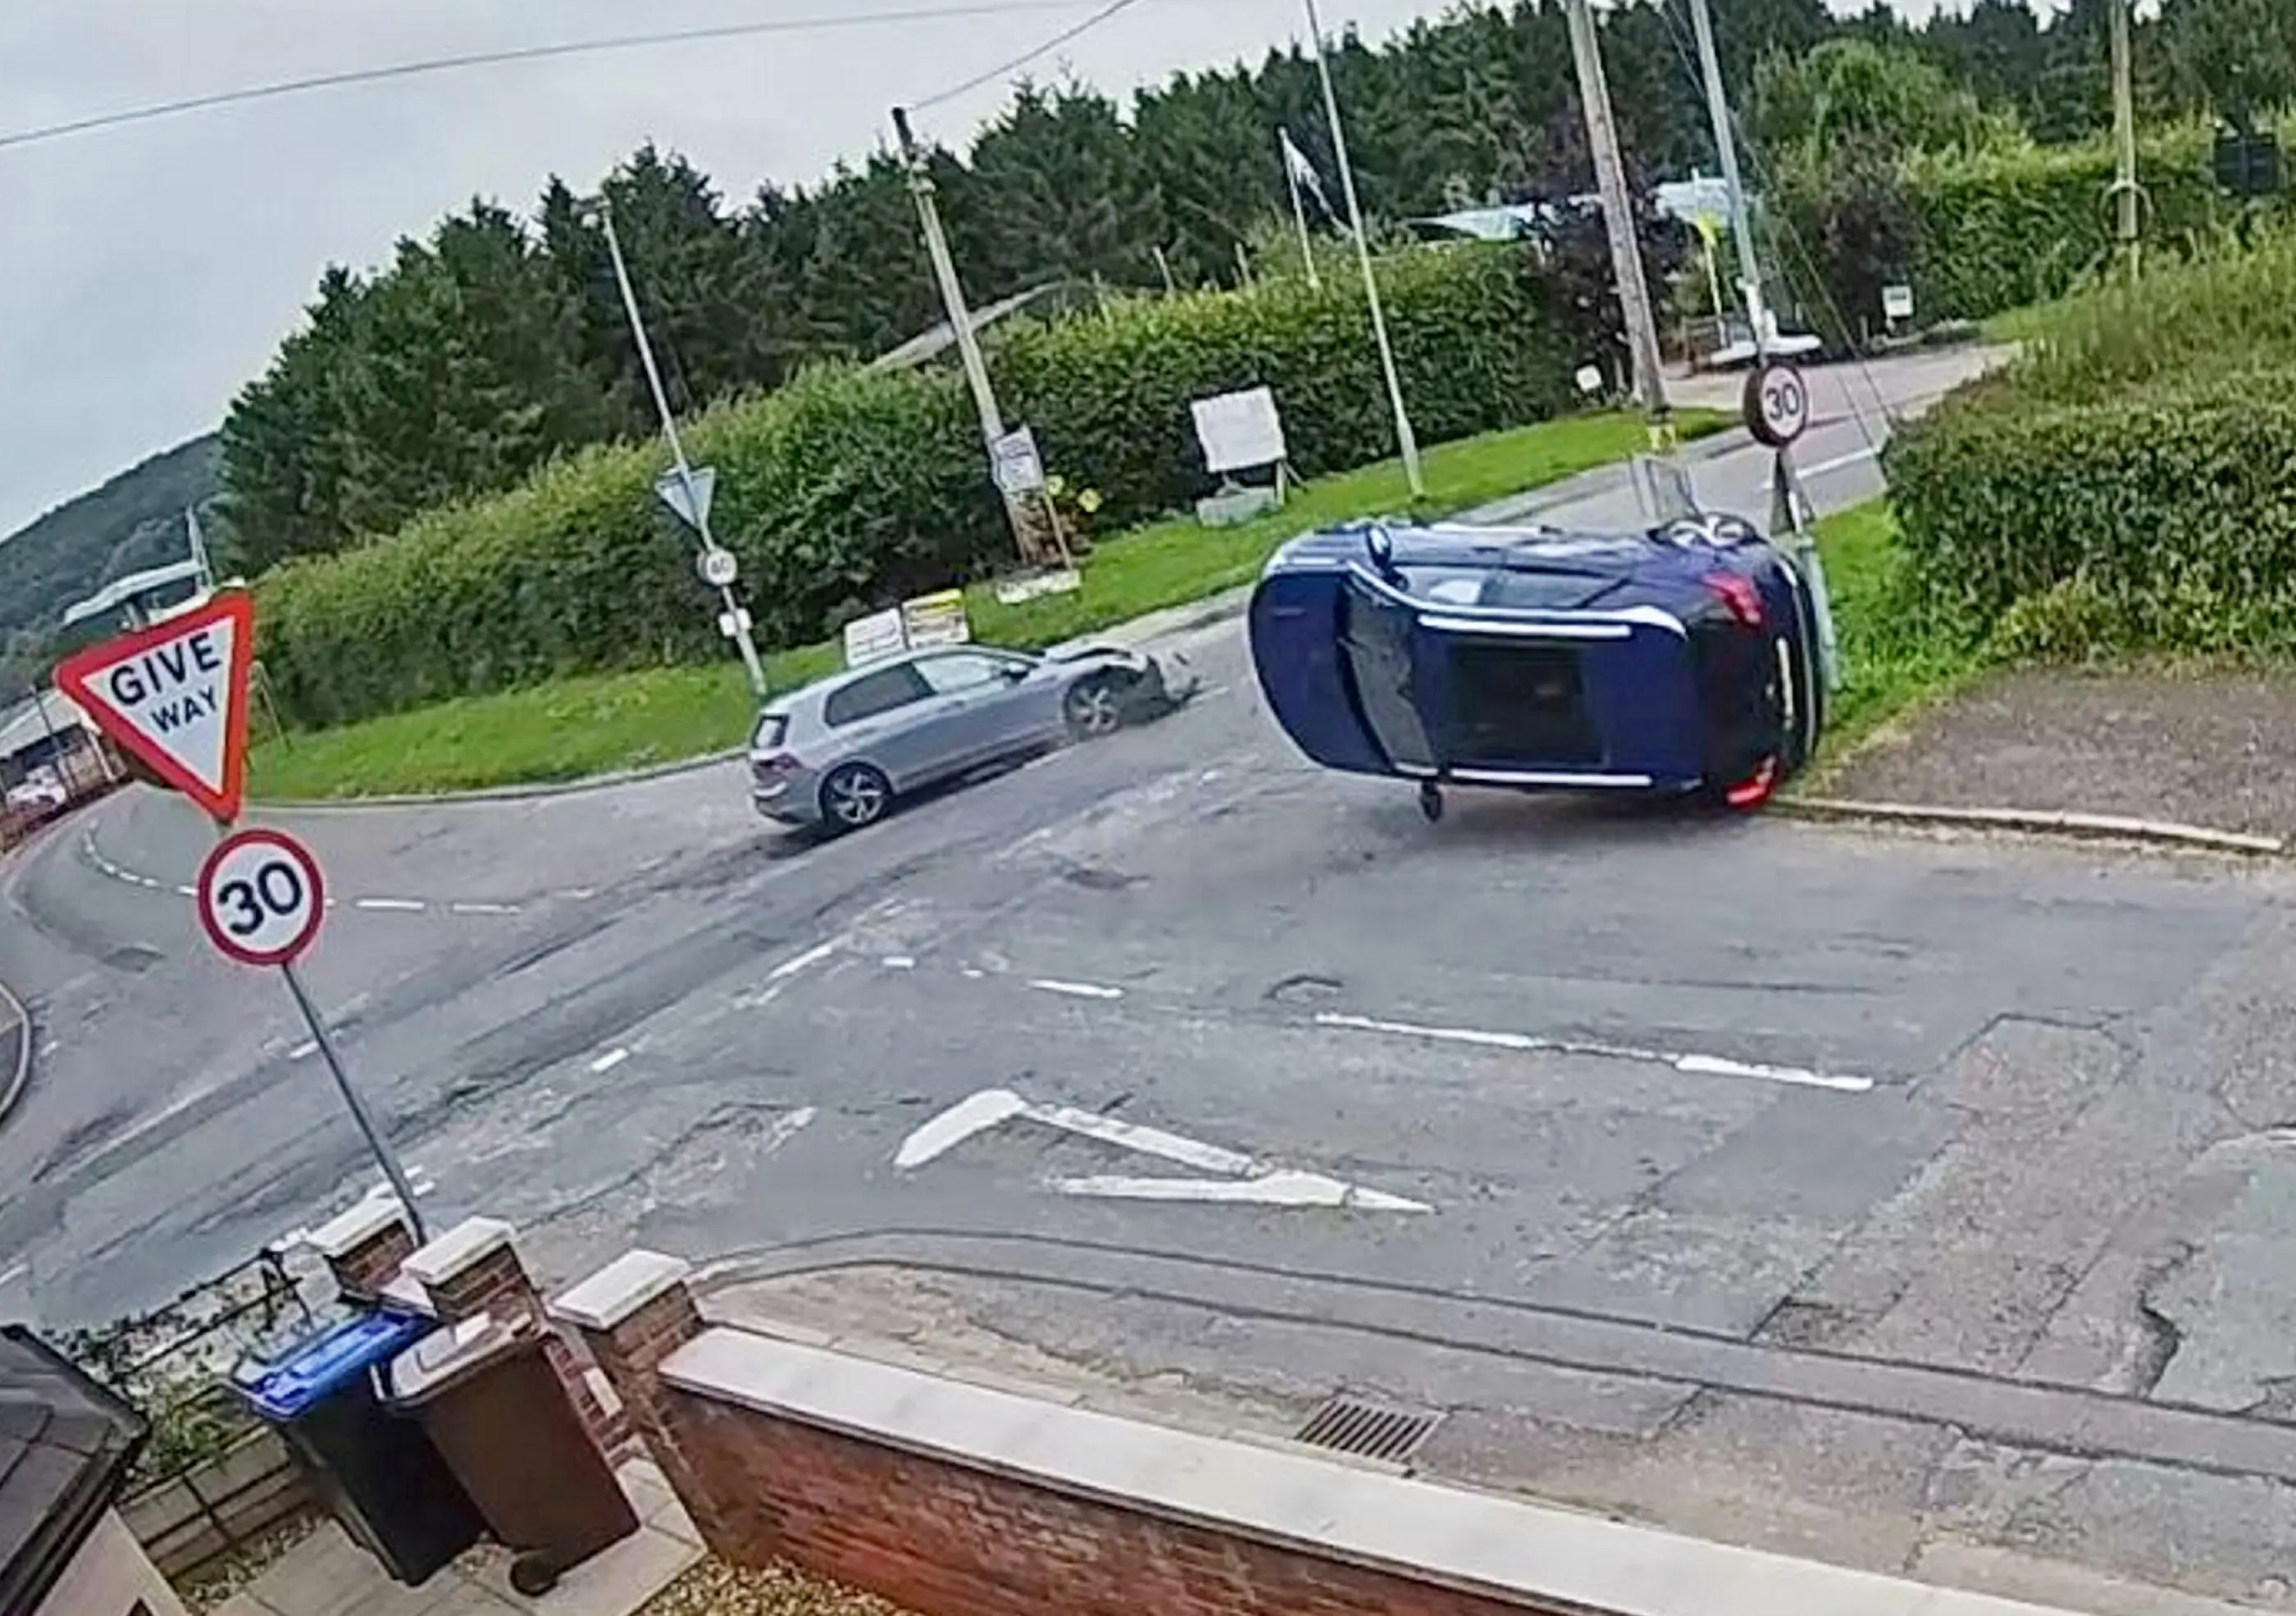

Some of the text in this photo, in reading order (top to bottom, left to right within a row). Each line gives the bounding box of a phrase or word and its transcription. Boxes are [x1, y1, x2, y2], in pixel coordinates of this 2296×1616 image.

[1765, 383, 1800, 421] 30
[110, 632, 221, 706] GIVE
[150, 685, 217, 733] WAY
[217, 861, 302, 935] 30
